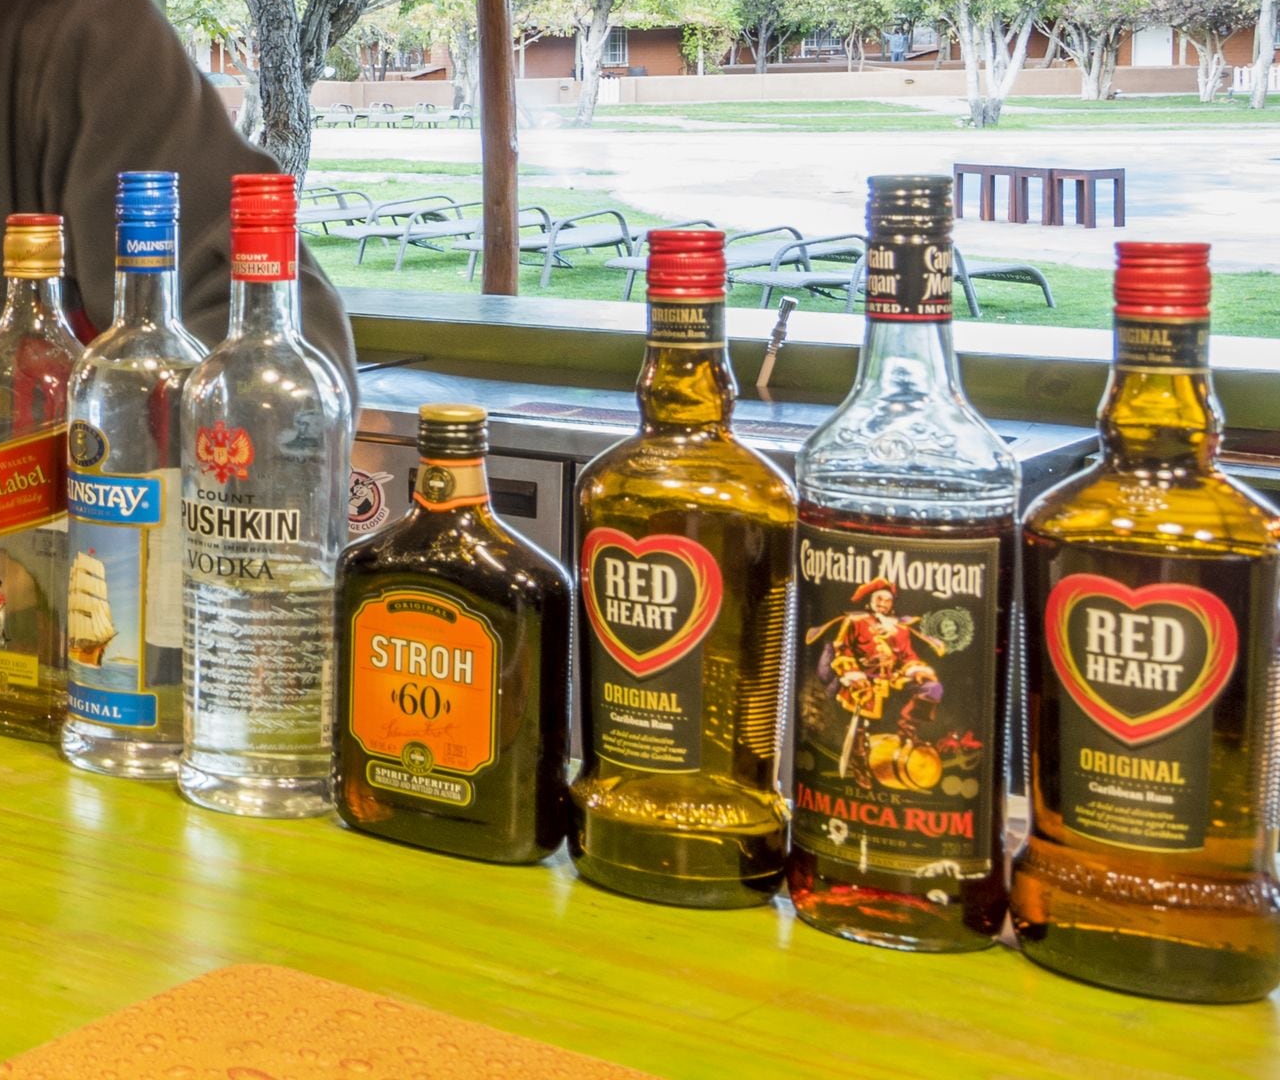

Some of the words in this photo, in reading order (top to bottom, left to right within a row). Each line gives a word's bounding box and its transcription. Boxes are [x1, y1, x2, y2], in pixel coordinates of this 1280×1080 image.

[652, 308, 706, 323] ORIGINAL
[197, 489, 256, 505] COUNT
[187, 549, 274, 580] VODKA
[800, 539, 871, 585] Captain
[872, 549, 985, 599] Morgan
[604, 557, 678, 605] RED
[394, 601, 448, 617] ORIGINAL
[605, 598, 678, 631] HEART
[1085, 607, 1185, 663] RED
[370, 634, 473, 685] STROH
[1086, 653, 1184, 692] HEART
[604, 682, 683, 714] ORIGINAL
[610, 712, 650, 728] Caribbean
[651, 719, 674, 731] Rum
[375, 767, 410, 781] SPIRIT
[411, 775, 462, 793] APERITIF
[1080, 748, 1185, 785] ORIGINAL
[844, 786, 902, 805] BLACK
[1089, 781, 1144, 801] Caribbean
[1145, 791, 1174, 804] Rum
[797, 782, 899, 830] JAMAICA
[904, 807, 975, 840] RUM
